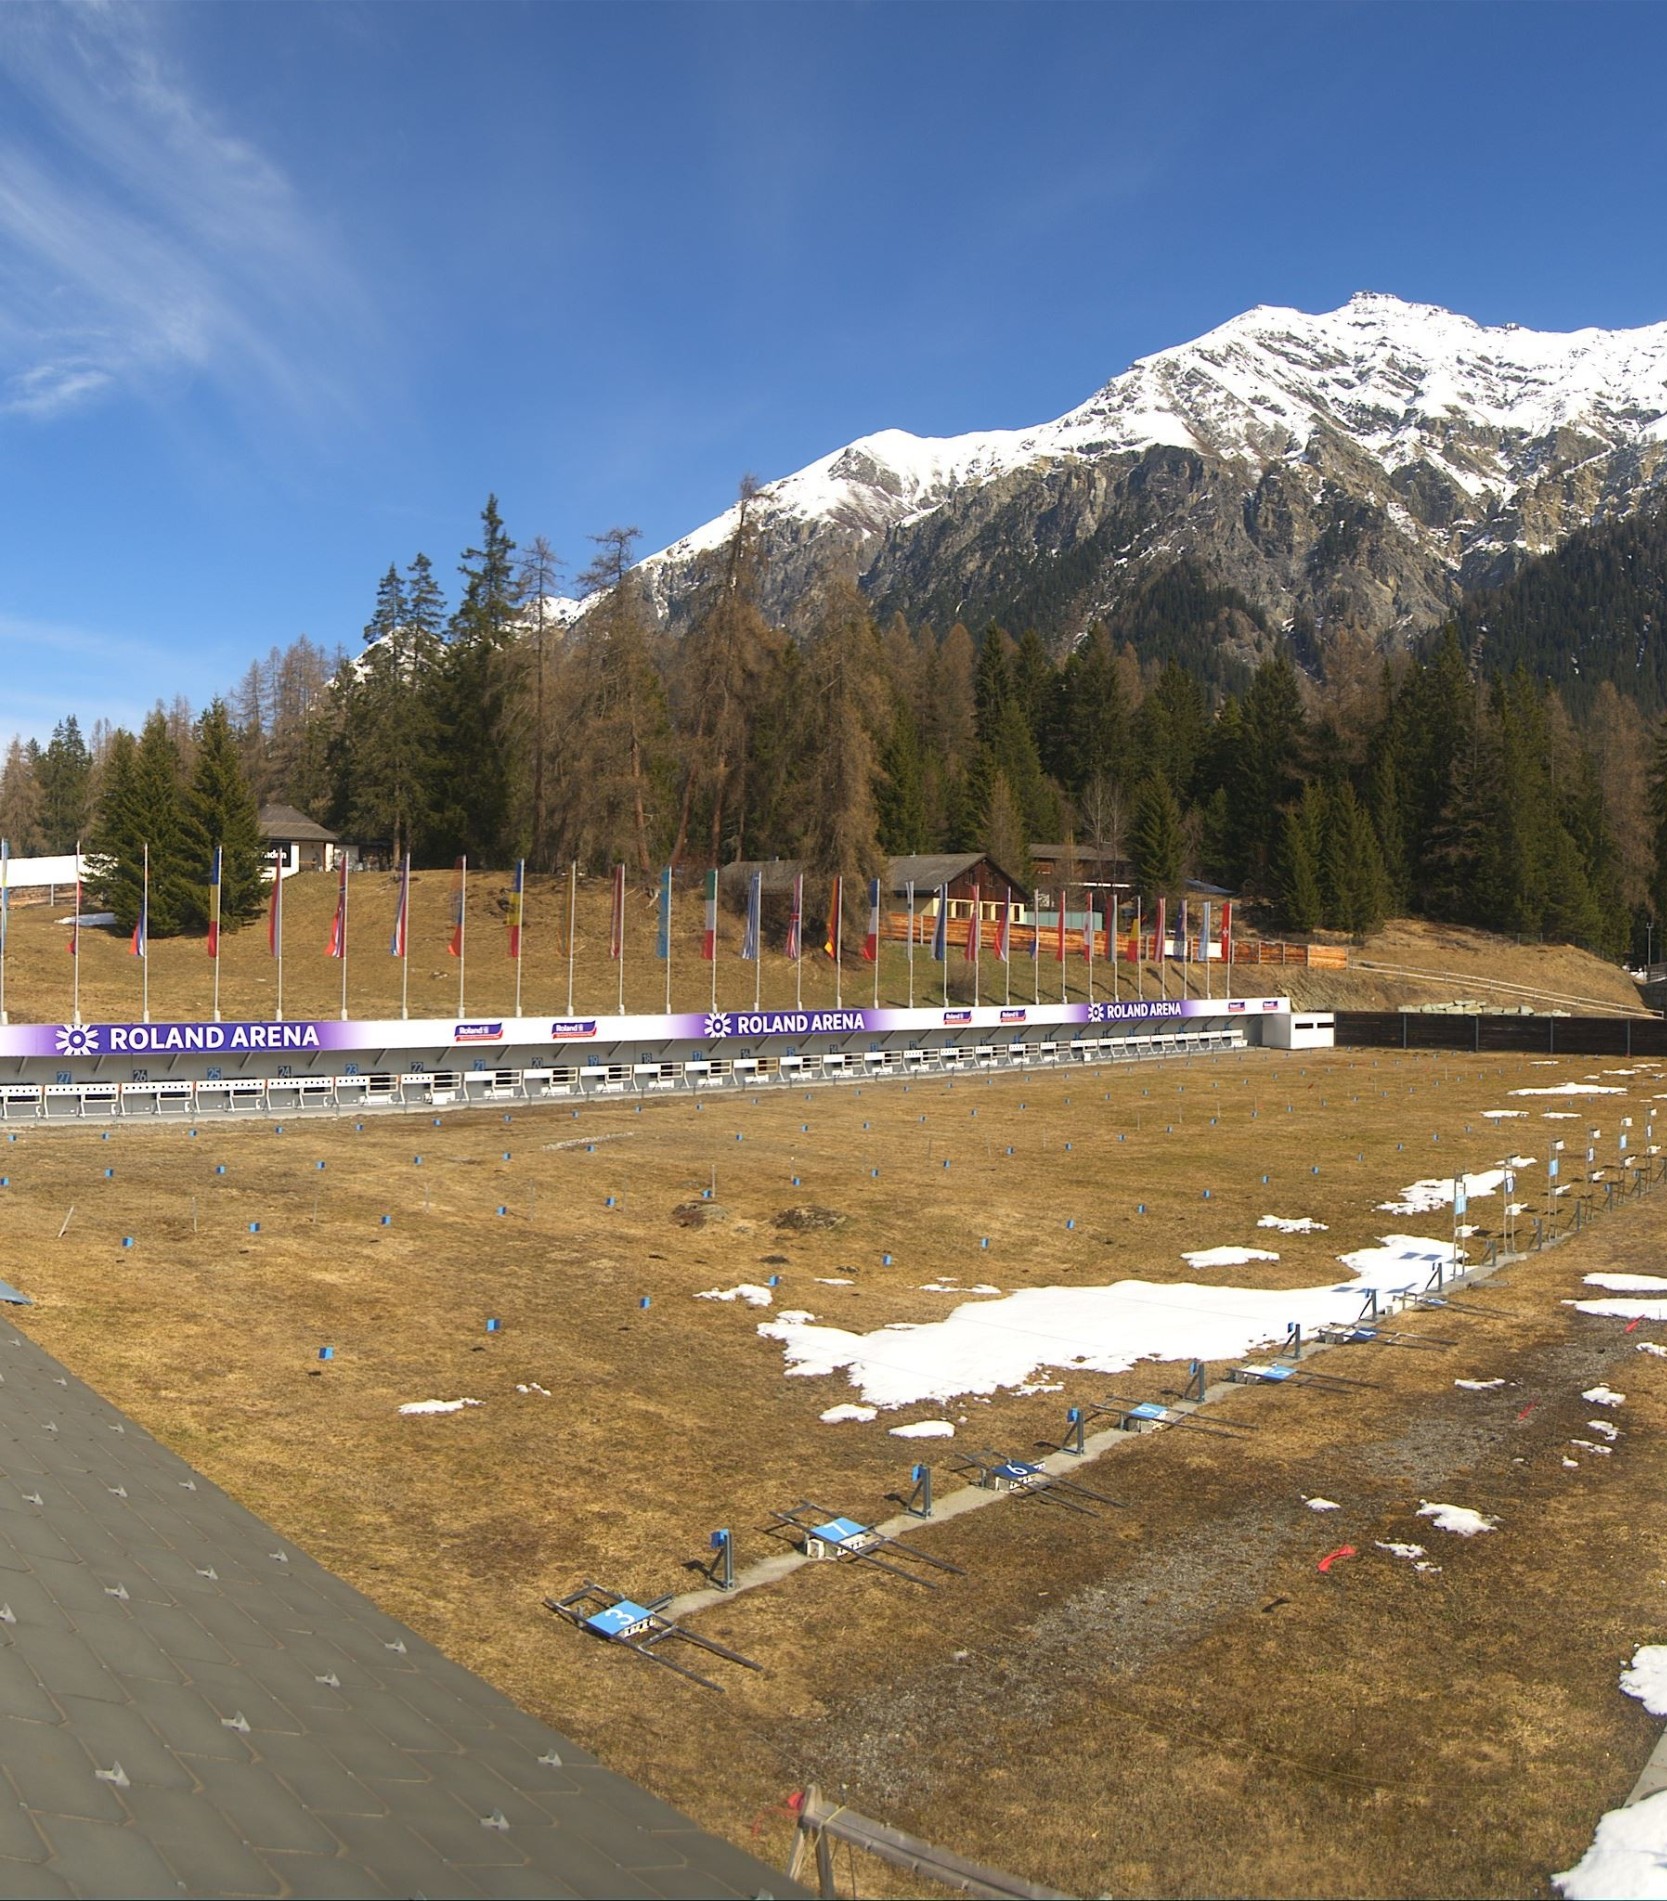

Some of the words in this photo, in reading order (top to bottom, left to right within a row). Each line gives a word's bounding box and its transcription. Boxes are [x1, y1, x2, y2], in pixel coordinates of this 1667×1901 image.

[1107, 1003, 1149, 1018] ROLAND
[1150, 1001, 1181, 1016] ARENA
[556, 1023, 578, 1033] Roland
[737, 1014, 808, 1033] ROLAND
[811, 1013, 865, 1031] ARENA
[459, 1025, 483, 1035] Roland
[111, 1026, 225, 1050] ROLAND
[230, 1025, 320, 1048] ARENA
[412, 1062, 424, 1073] 22
[474, 1060, 485, 1070] 21
[532, 1058, 543, 1068] 20
[208, 1067, 221, 1080] 25
[279, 1066, 291, 1077] 24
[346, 1064, 358, 1075] 23
[58, 1072, 71, 1084] 27
[134, 1070, 147, 1082] 26
[830, 1522, 849, 1536] 7
[605, 1609, 635, 1625] 3
